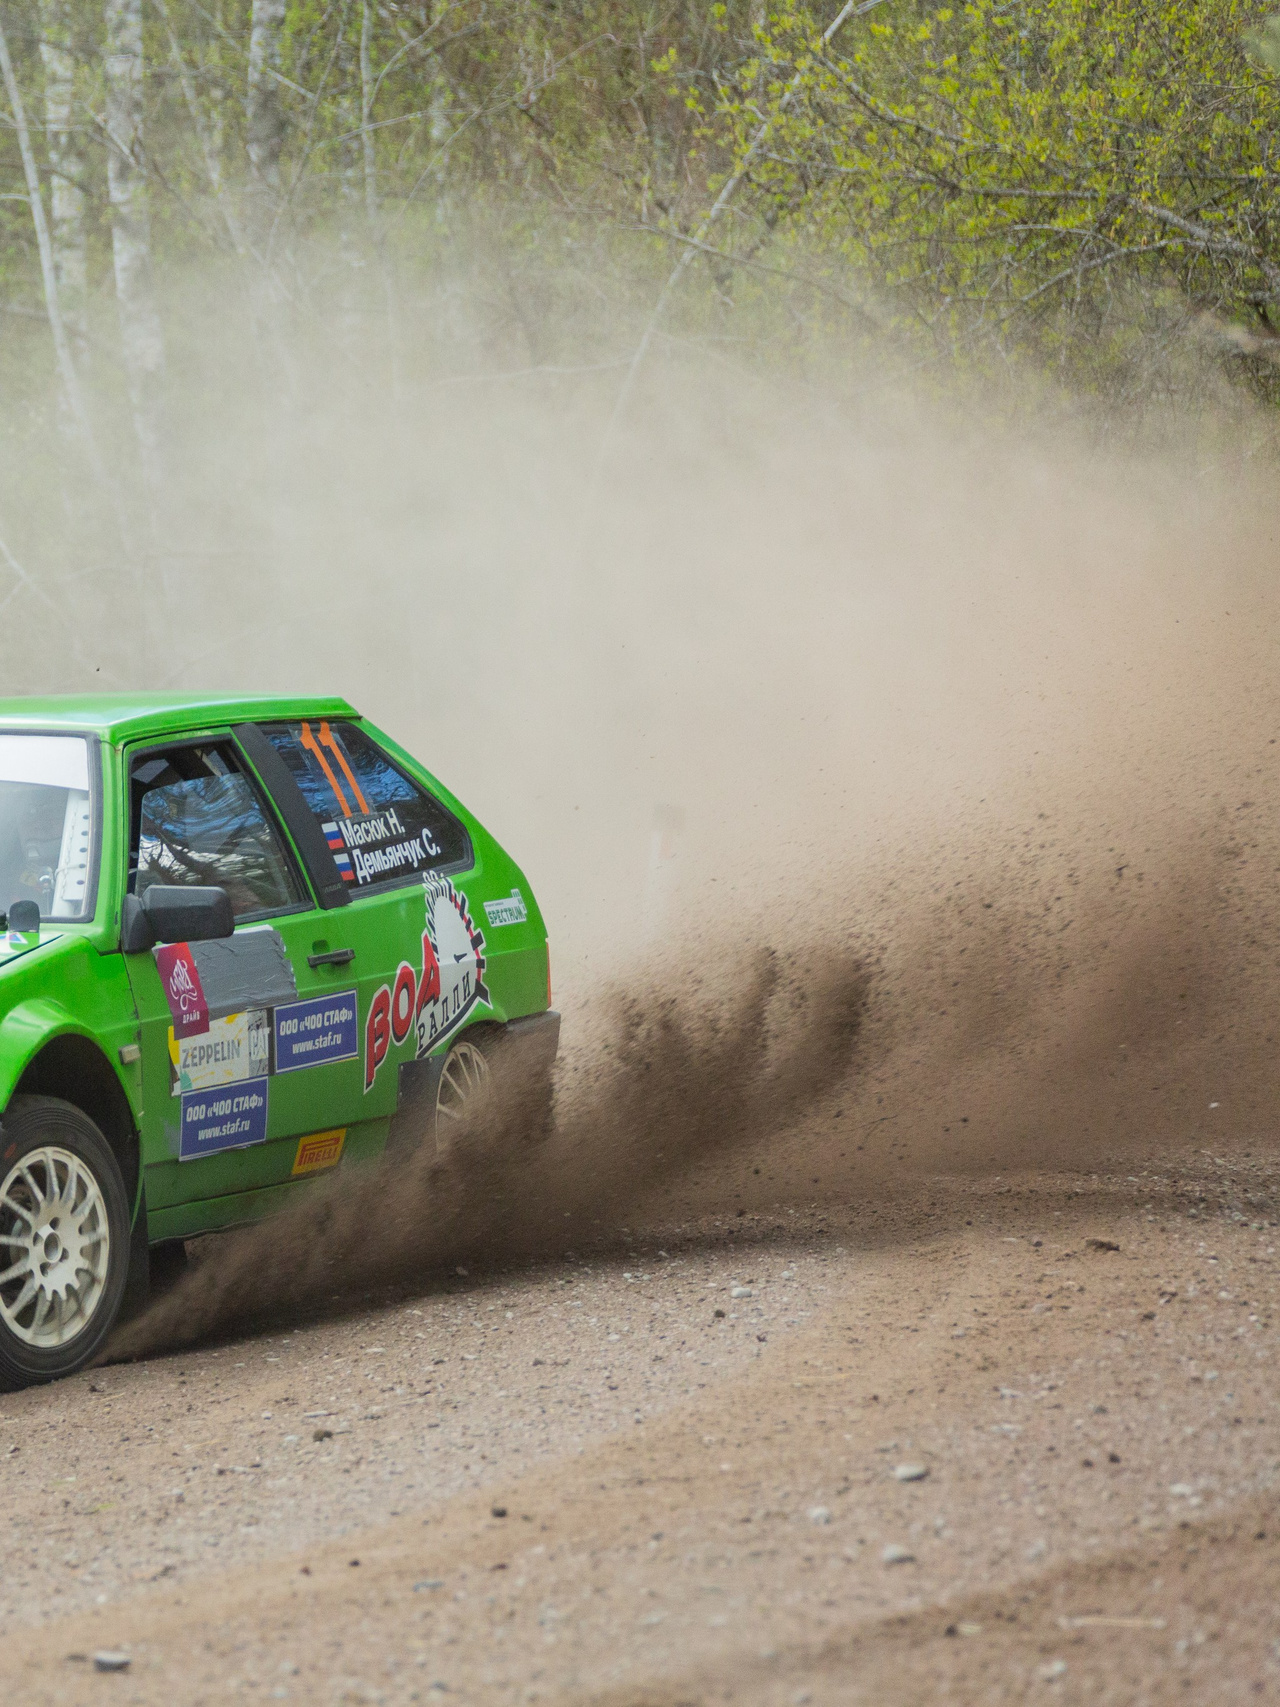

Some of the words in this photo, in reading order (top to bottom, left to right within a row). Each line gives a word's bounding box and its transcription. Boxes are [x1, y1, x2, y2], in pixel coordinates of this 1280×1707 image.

[299, 721, 370, 818] 11
[338, 815, 389, 848] Масюк
[385, 807, 406, 835] Н.
[352, 839, 424, 885] Демьянчук
[422, 827, 442, 856] С.
[487, 906, 526, 925] SPECTRUM
[182, 1009, 201, 1024] ДРАЙВ
[279, 1017, 299, 1036] ООО
[323, 1007, 353, 1027] СТАФ»
[418, 970, 472, 1051] РАЛЛИ
[182, 1040, 242, 1069] ZEPPELIN
[292, 1031, 342, 1054] www.staf.ru
[186, 1104, 206, 1122] ООО
[232, 1093, 264, 1114] СТАФ»
[198, 1118, 250, 1141] www.staf.ru
[297, 1136, 342, 1167] PIRELLI
